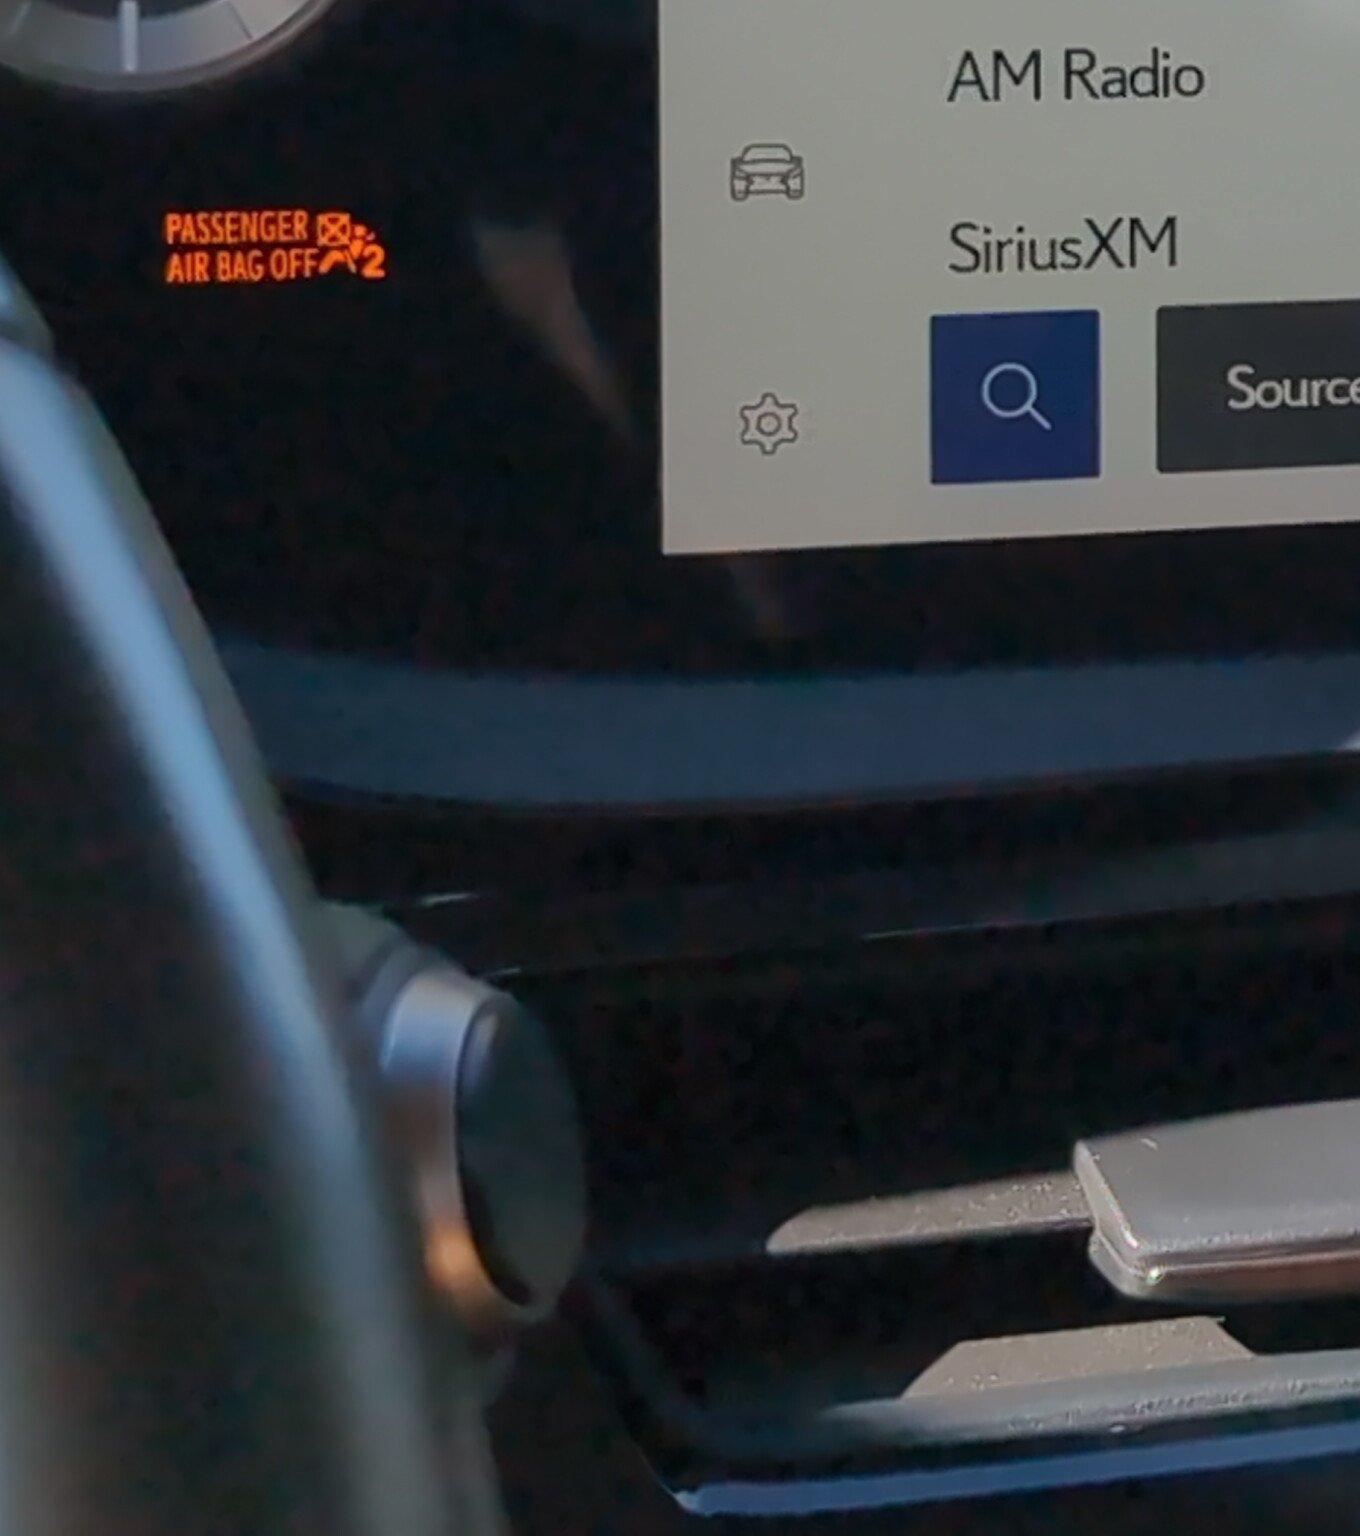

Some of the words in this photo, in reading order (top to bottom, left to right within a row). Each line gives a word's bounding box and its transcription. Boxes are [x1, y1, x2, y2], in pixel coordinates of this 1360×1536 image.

[946, 48, 1042, 103] AM
[1063, 46, 1205, 101] Radio
[165, 211, 309, 244] PASSENGER
[948, 215, 1177, 274] SiriusXM
[166, 252, 210, 282] AIR
[215, 250, 264, 282] BAG
[269, 248, 319, 281] OFF
